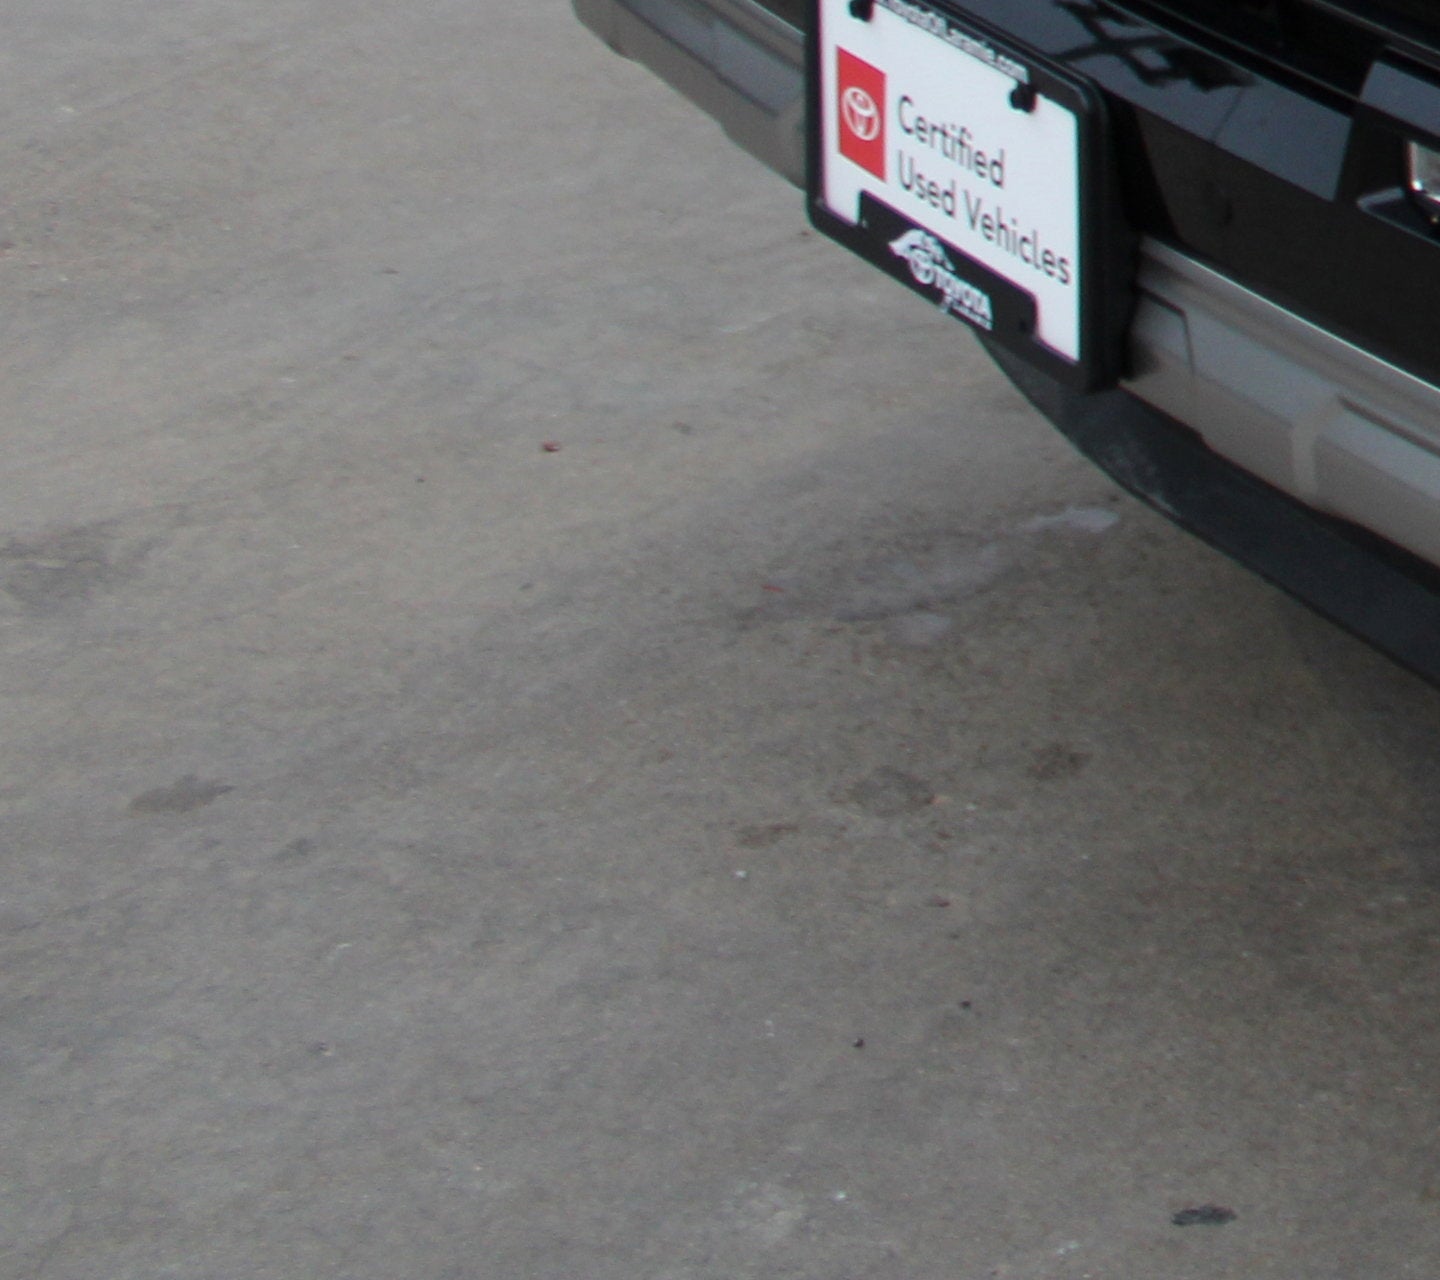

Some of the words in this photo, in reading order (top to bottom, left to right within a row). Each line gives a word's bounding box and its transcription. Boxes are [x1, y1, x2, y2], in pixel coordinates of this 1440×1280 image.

[898, 95, 1005, 189] Certified
[898, 149, 956, 217] Used
[964, 188, 1072, 286] Vehicles
